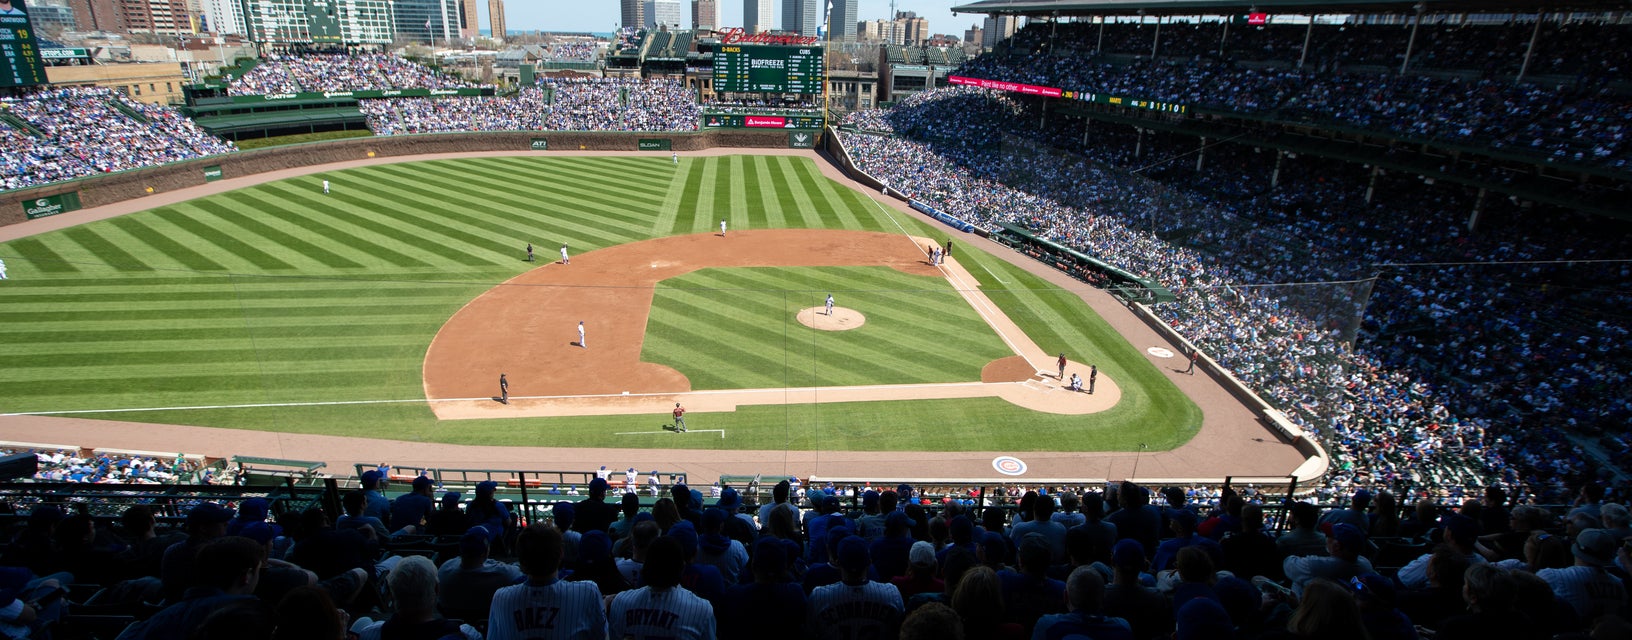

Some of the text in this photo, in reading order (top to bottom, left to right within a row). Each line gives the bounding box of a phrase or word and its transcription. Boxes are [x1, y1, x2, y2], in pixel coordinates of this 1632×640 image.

[17, 29, 28, 39] 19
[719, 27, 817, 45] Budweiser
[27, 204, 62, 214] Gallagher
[626, 608, 679, 630] BRYANT
